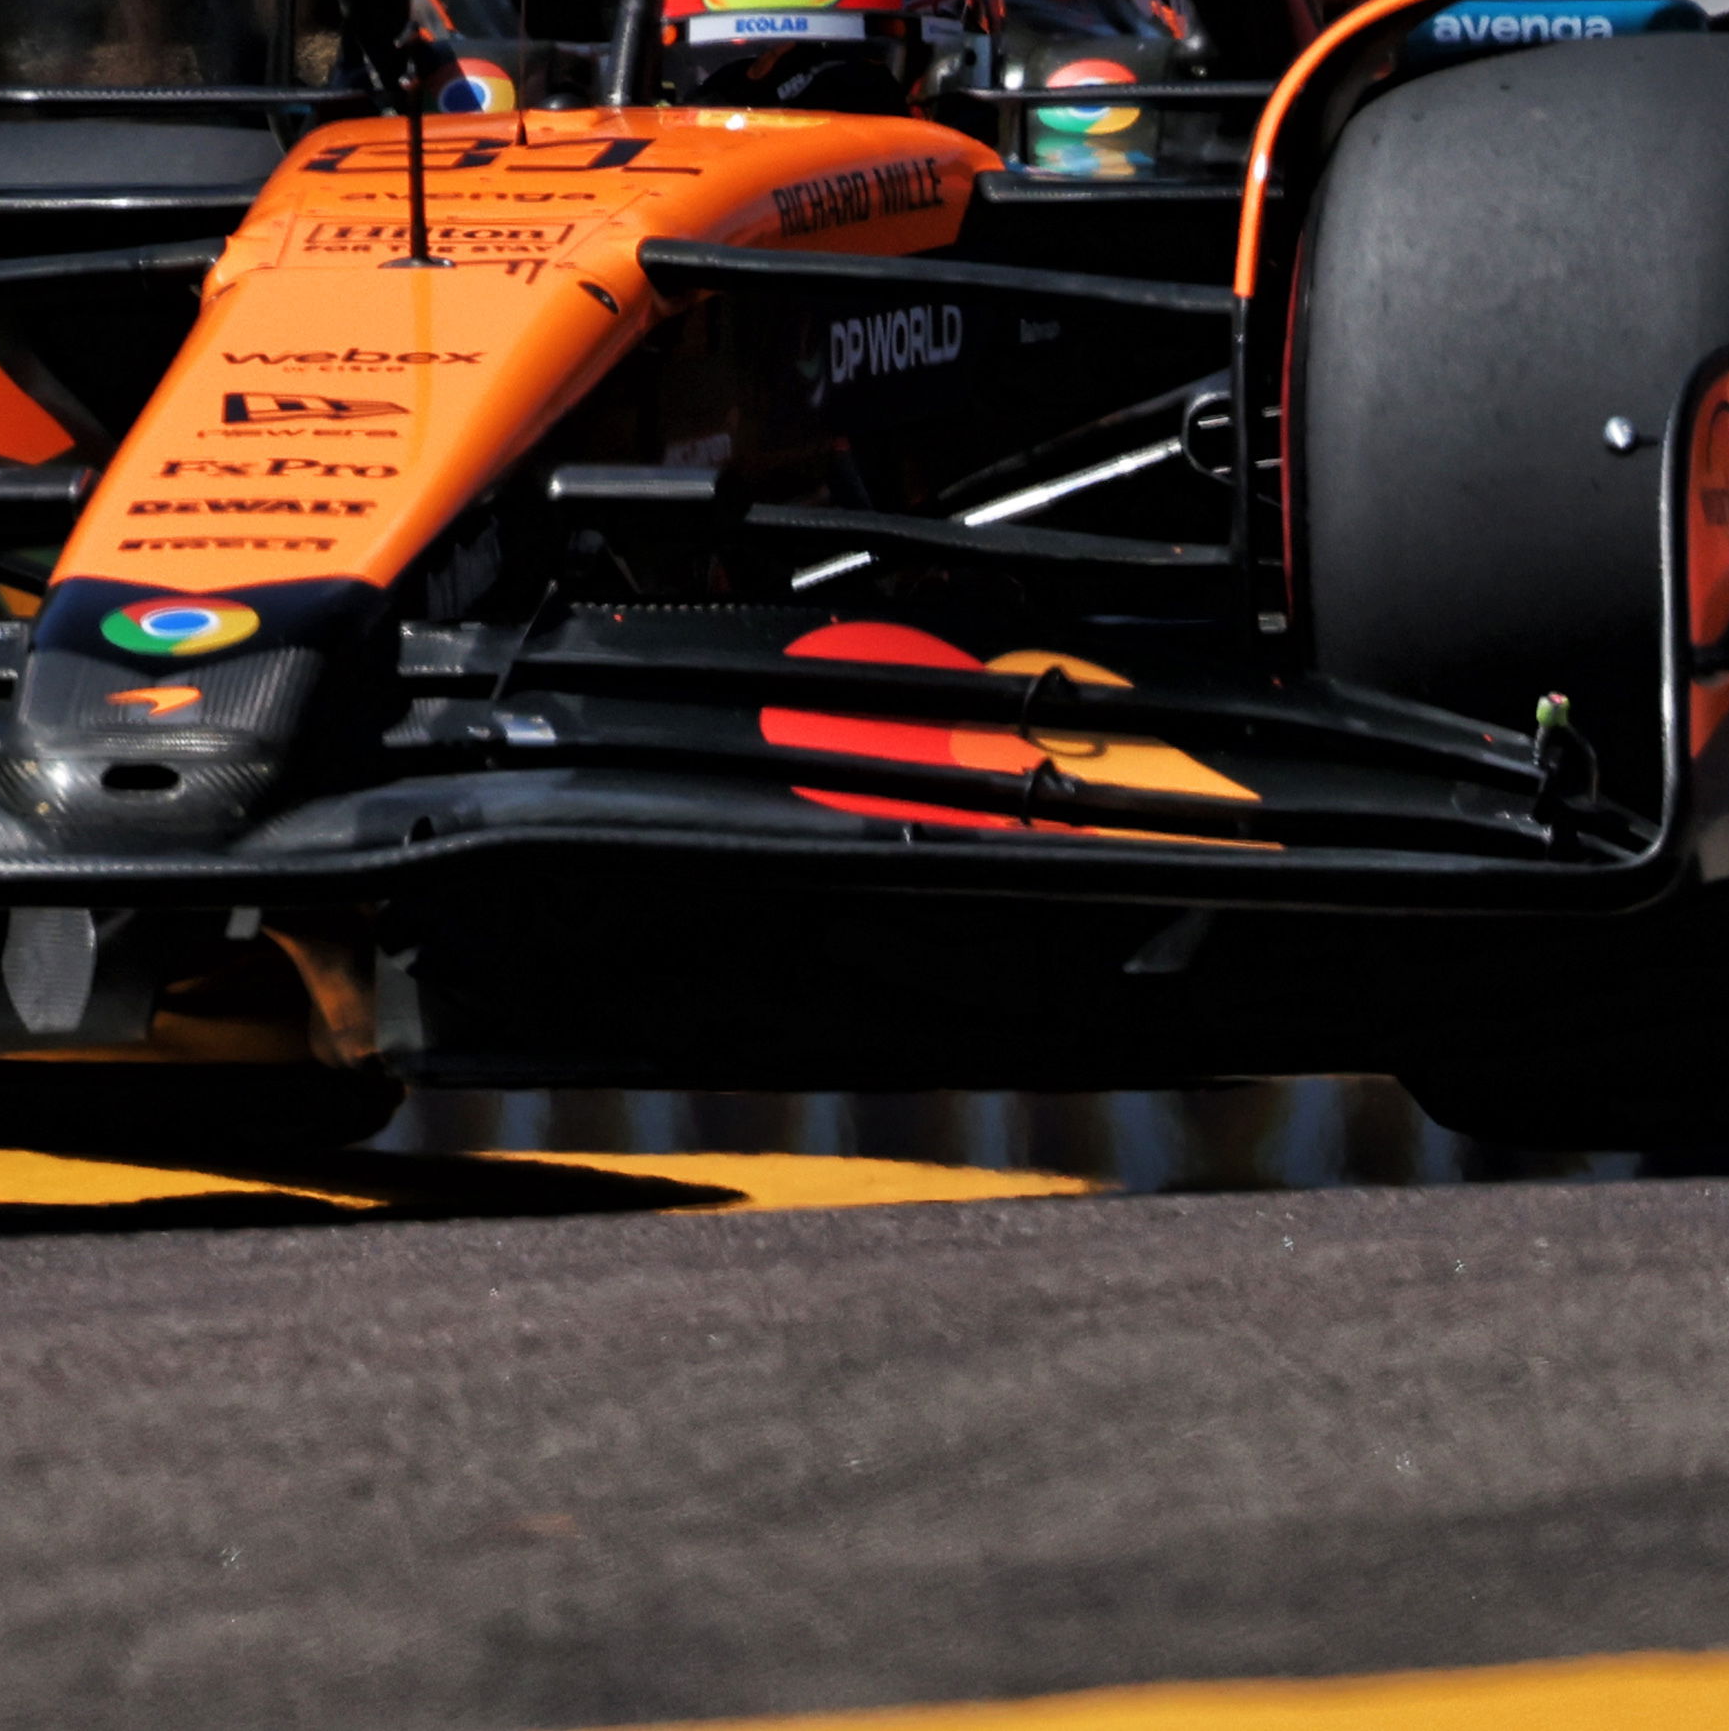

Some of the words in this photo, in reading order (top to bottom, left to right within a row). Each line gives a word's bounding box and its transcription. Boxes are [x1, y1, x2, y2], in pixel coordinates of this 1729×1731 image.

[735, 17, 808, 33] ECOLAB
[1432, 11, 1613, 42] avenga
[772, 171, 871, 238] RICHARD
[874, 157, 944, 216] MILLE
[333, 225, 545, 240] Hiton
[829, 318, 863, 384] DP
[866, 303, 963, 376] WORLD
[222, 348, 486, 365] webex
